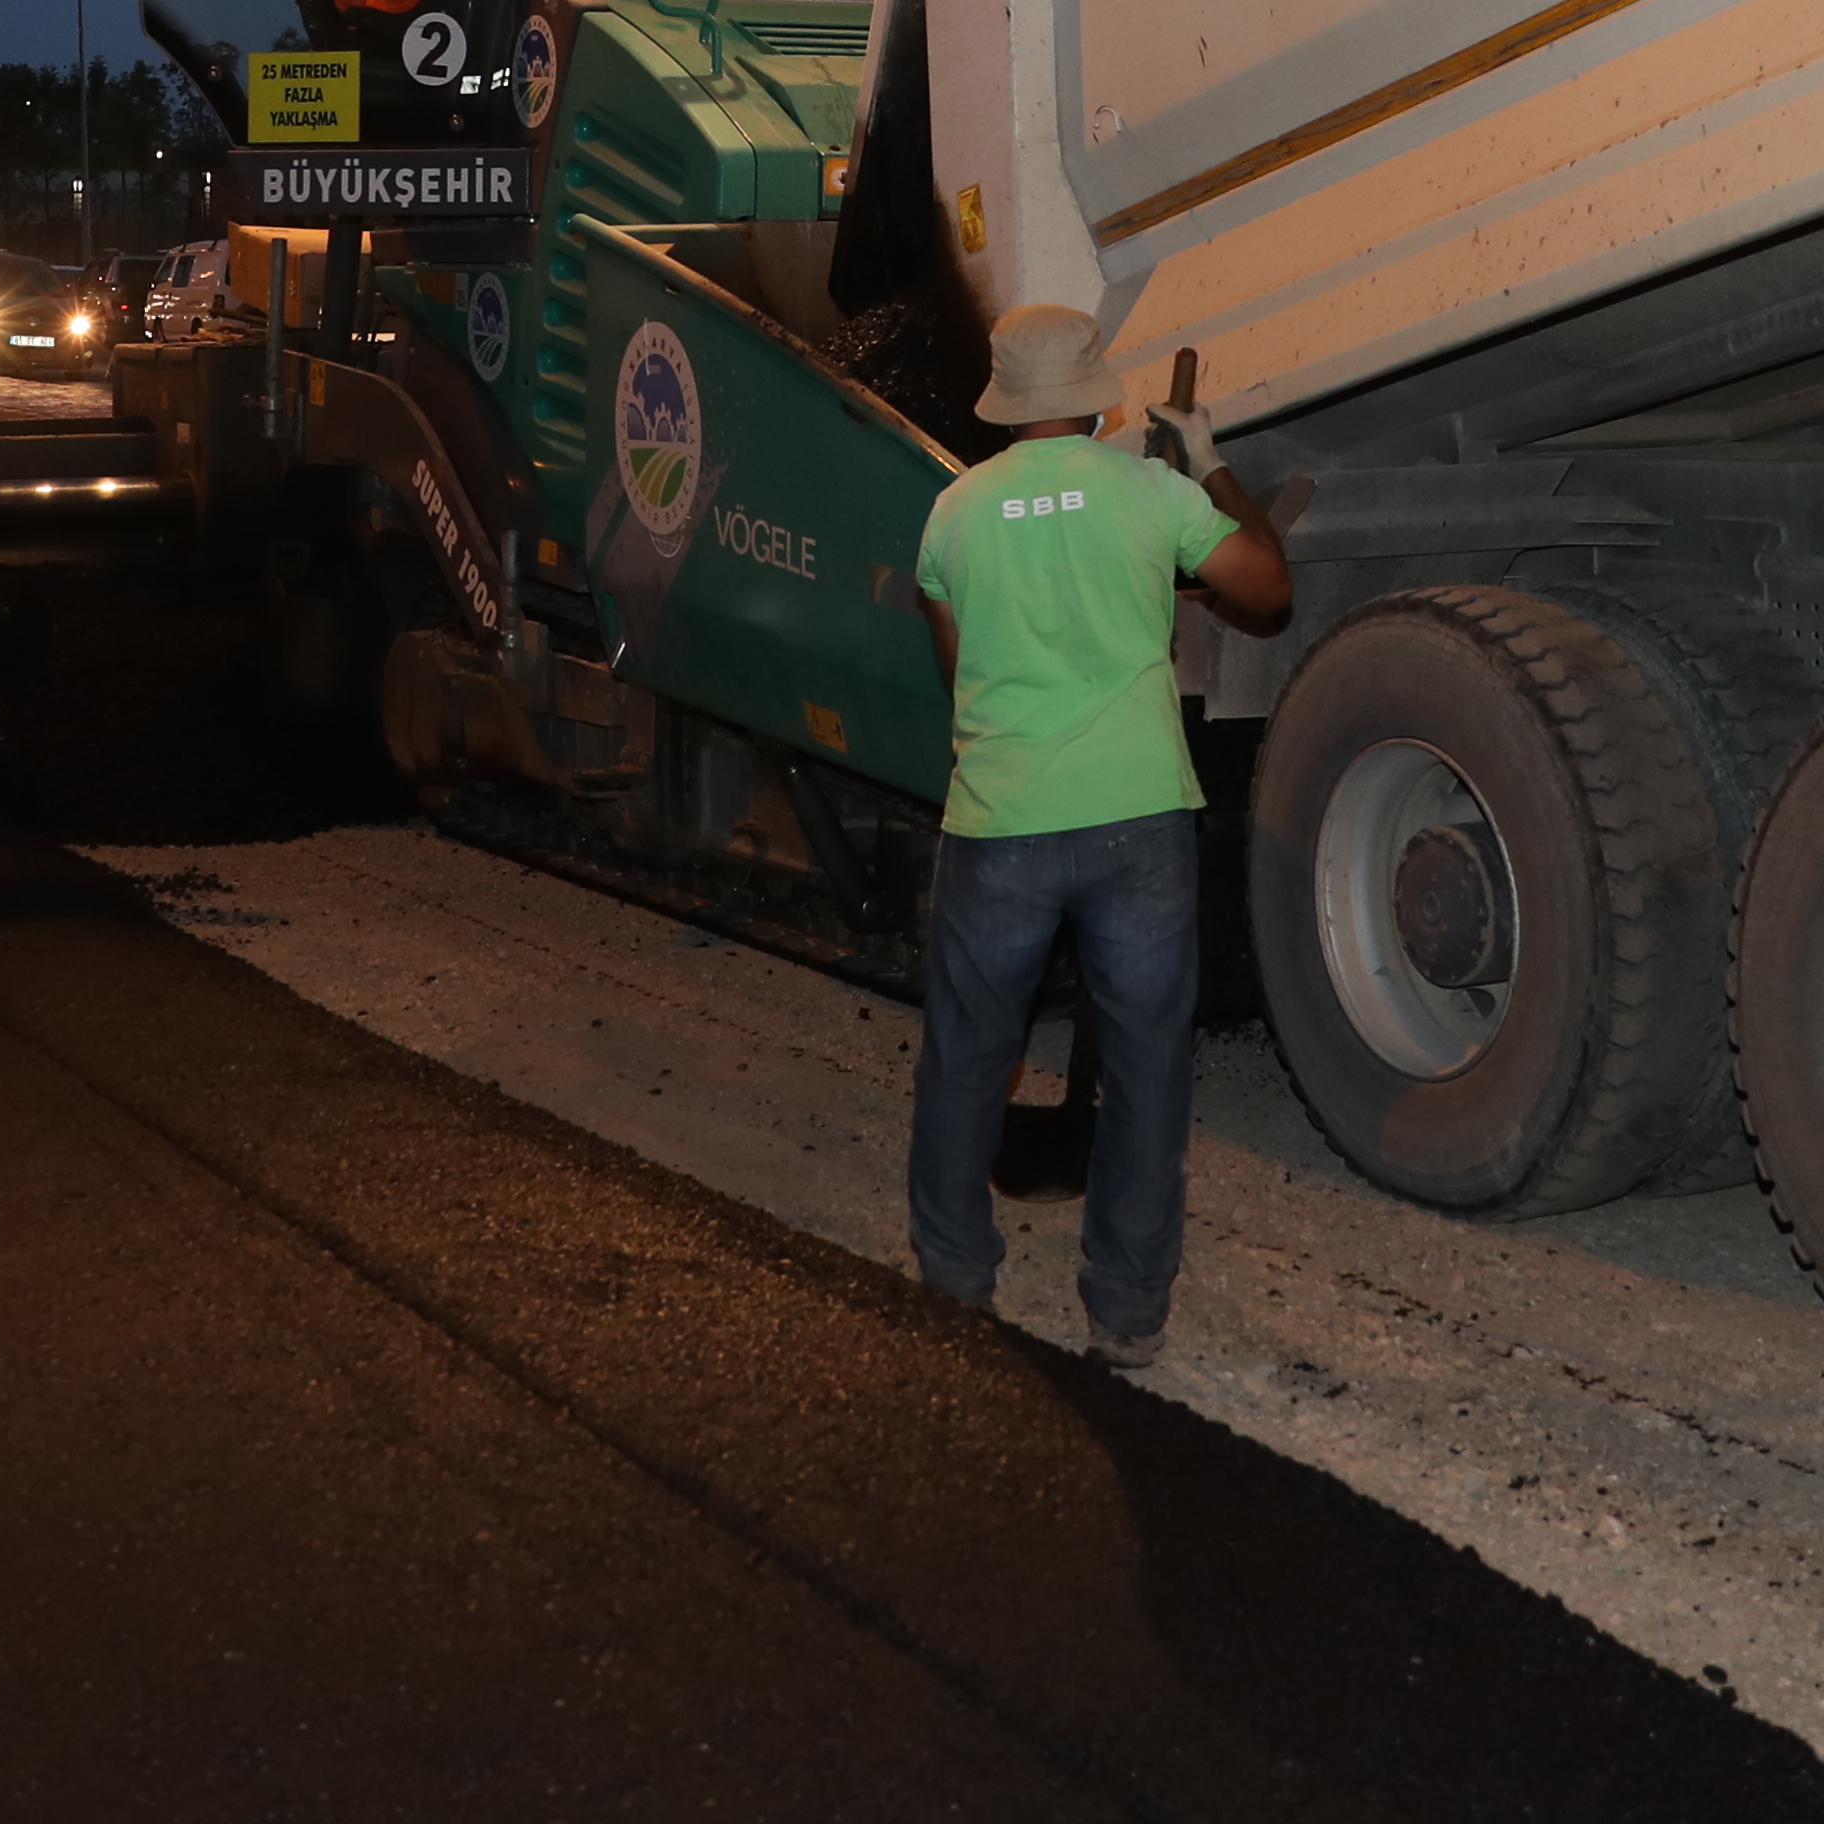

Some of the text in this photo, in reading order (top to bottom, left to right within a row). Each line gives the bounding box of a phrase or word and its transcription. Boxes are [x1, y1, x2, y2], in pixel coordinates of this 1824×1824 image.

[416, 22, 451, 78] 2
[262, 63, 347, 80] 25 METREDEN
[284, 87, 324, 103] FAZLA
[270, 110, 339, 131] YAKLAŞMA
[262, 157, 514, 209] BÜYÜKŞEHİR
[411, 458, 459, 558] SUPER
[1001, 489, 1086, 520] SBB
[713, 503, 817, 581] VÖGELE
